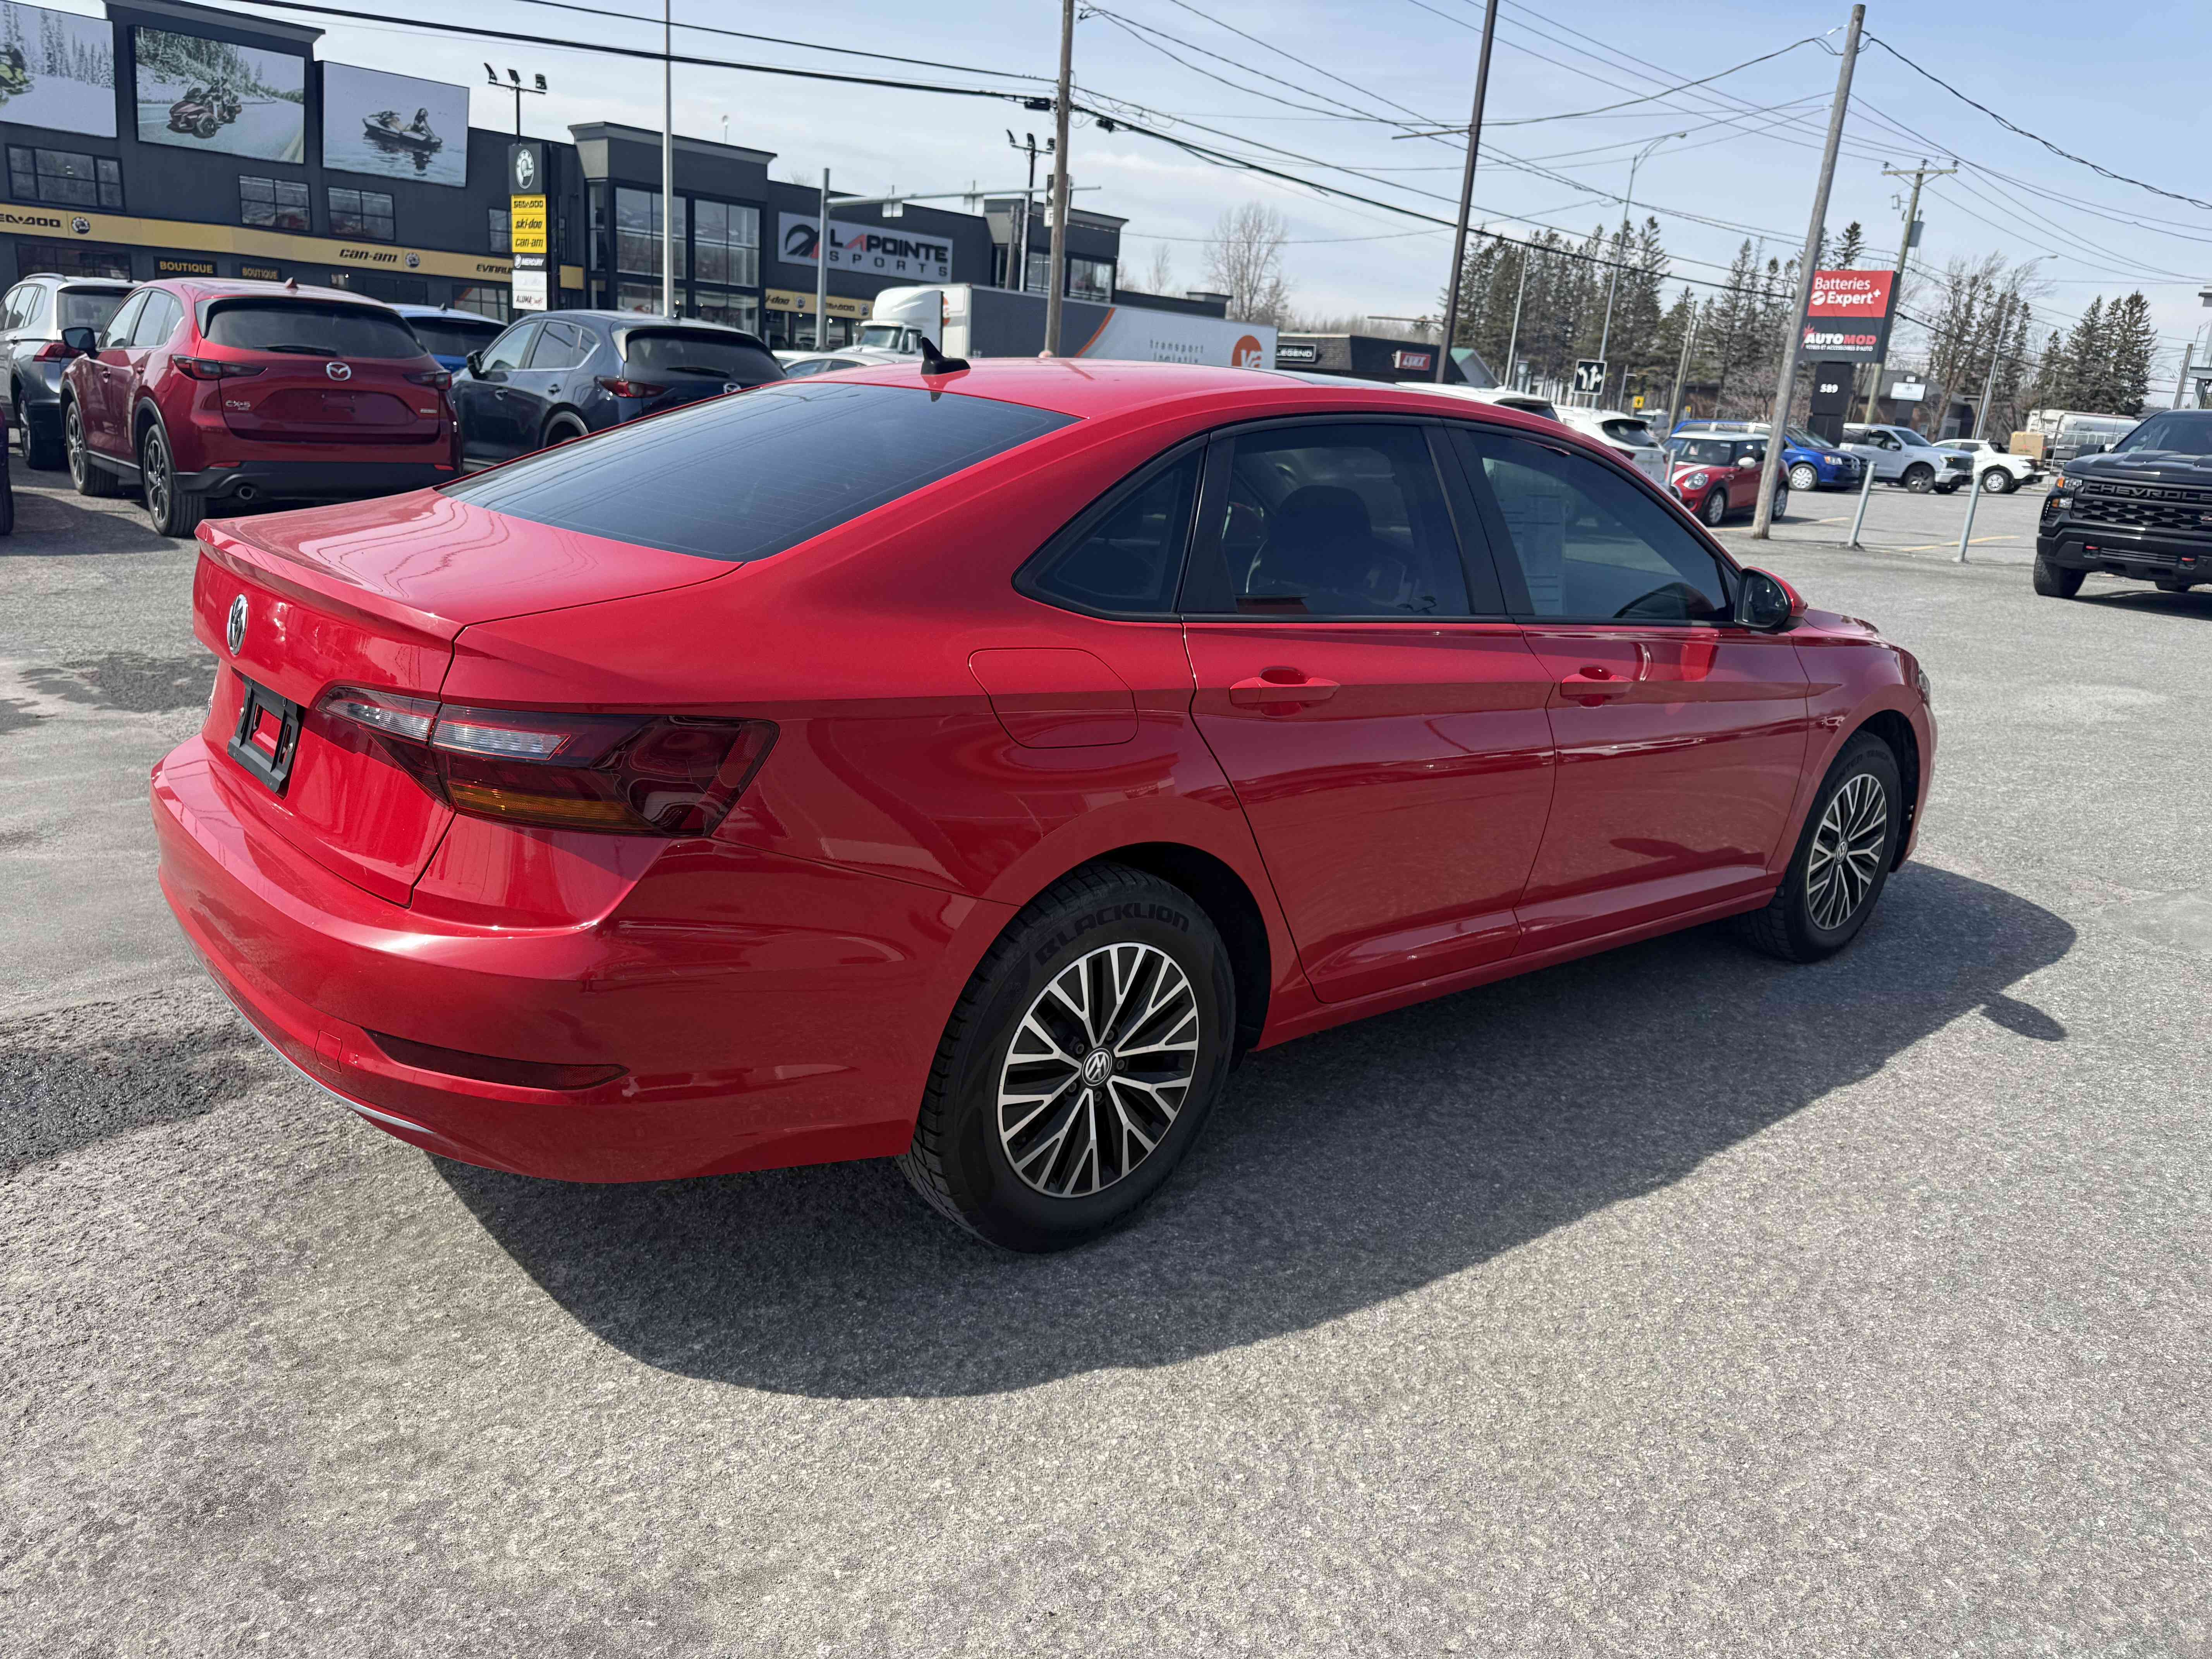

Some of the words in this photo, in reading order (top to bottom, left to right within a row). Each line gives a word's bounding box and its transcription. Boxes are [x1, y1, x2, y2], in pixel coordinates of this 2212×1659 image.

[515, 238, 543, 247] can-am
[830, 229, 948, 263] LAPOINTE
[339, 249, 398, 263] can-am
[160, 261, 213, 273] BOUTIQUE
[830, 250, 948, 277] SPORTS
[242, 267, 278, 279] BOUTIQUE
[1814, 277, 1871, 290] Batteries
[1805, 333, 1877, 345] AUTOMOD
[1149, 339, 1203, 354] transport
[1819, 383, 1838, 393] 589
[2087, 483, 2212, 501] CHEVROLE
[1035, 903, 1189, 965] BLACKLION
